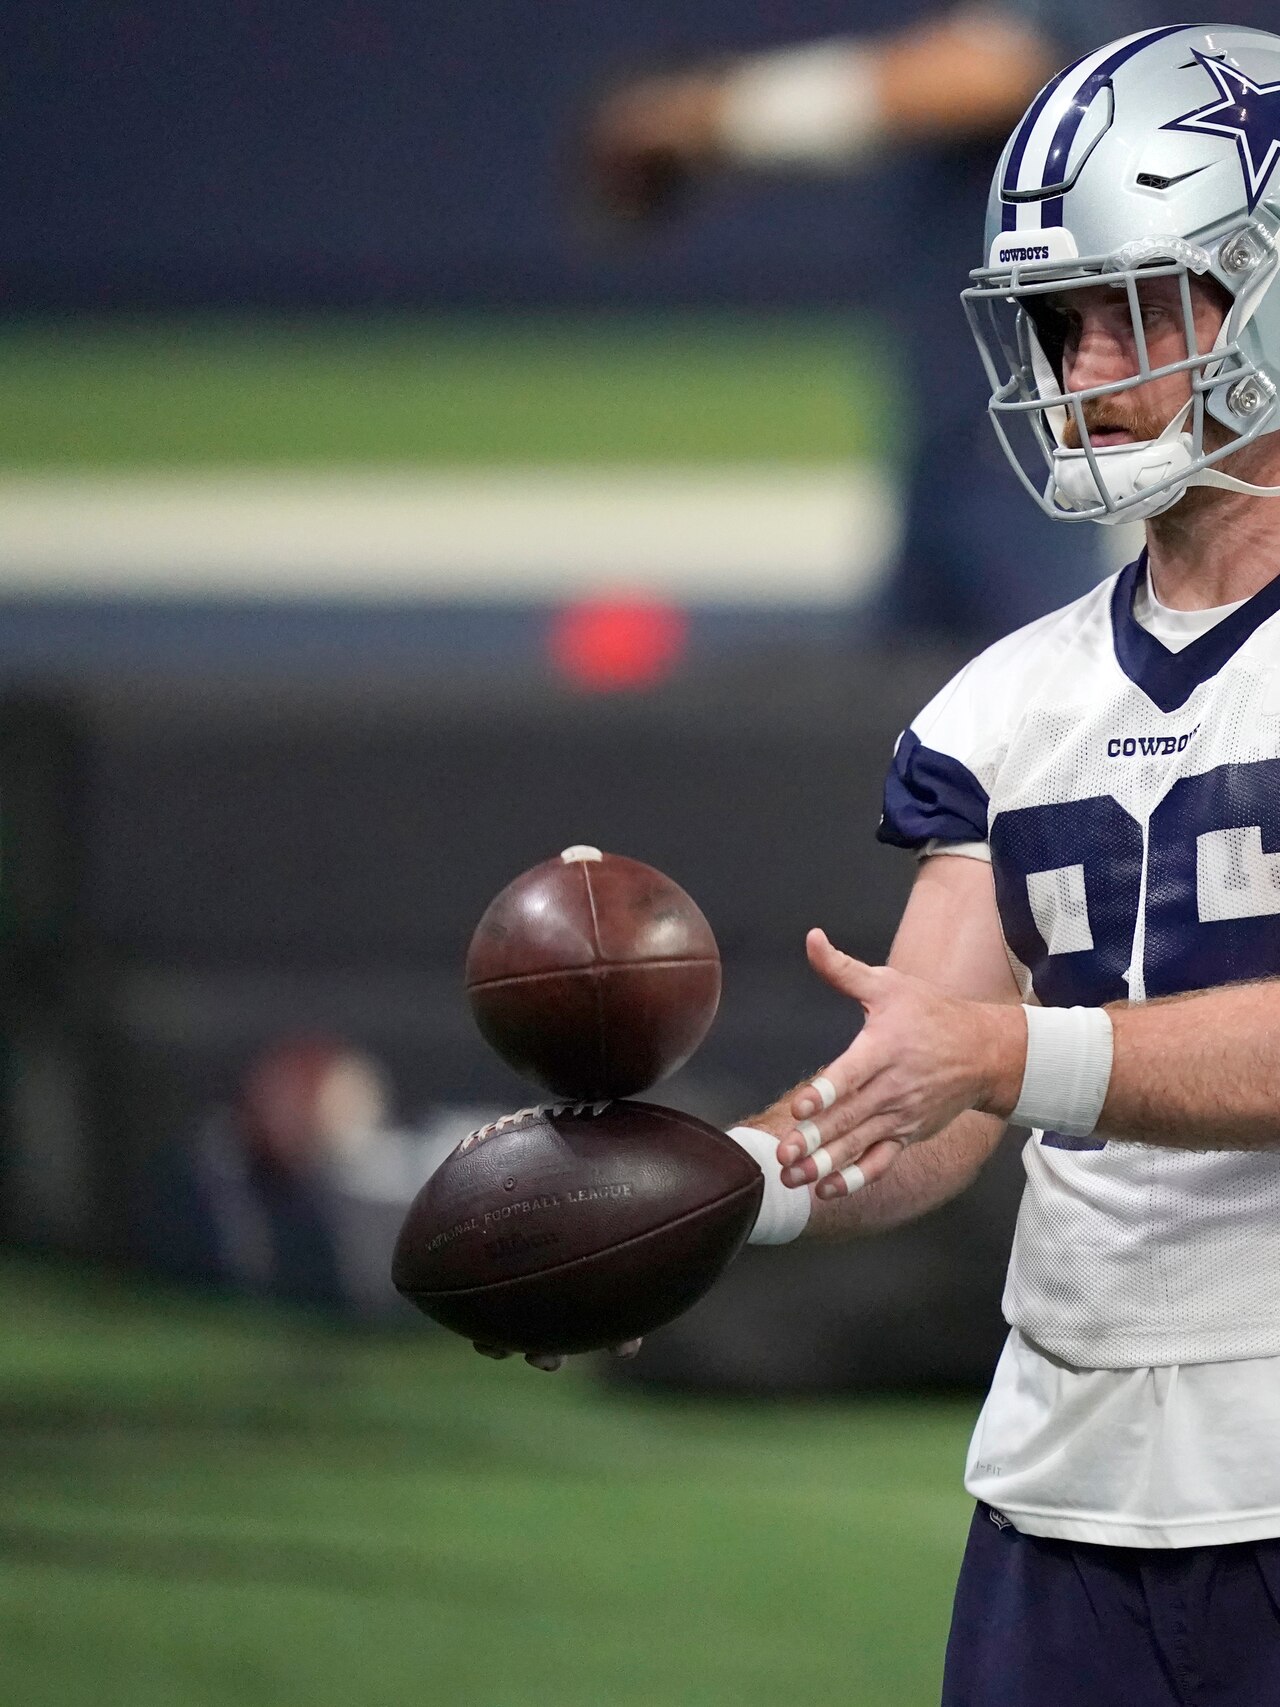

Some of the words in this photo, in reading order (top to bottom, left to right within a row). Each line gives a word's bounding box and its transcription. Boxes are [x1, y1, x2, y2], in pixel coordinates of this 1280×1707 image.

[999, 246, 1049, 262] COWBOYS
[1107, 722, 1201, 757] COWBO
[484, 1197, 561, 1227] FOOTBALL
[568, 1184, 631, 1203] LEAGUE
